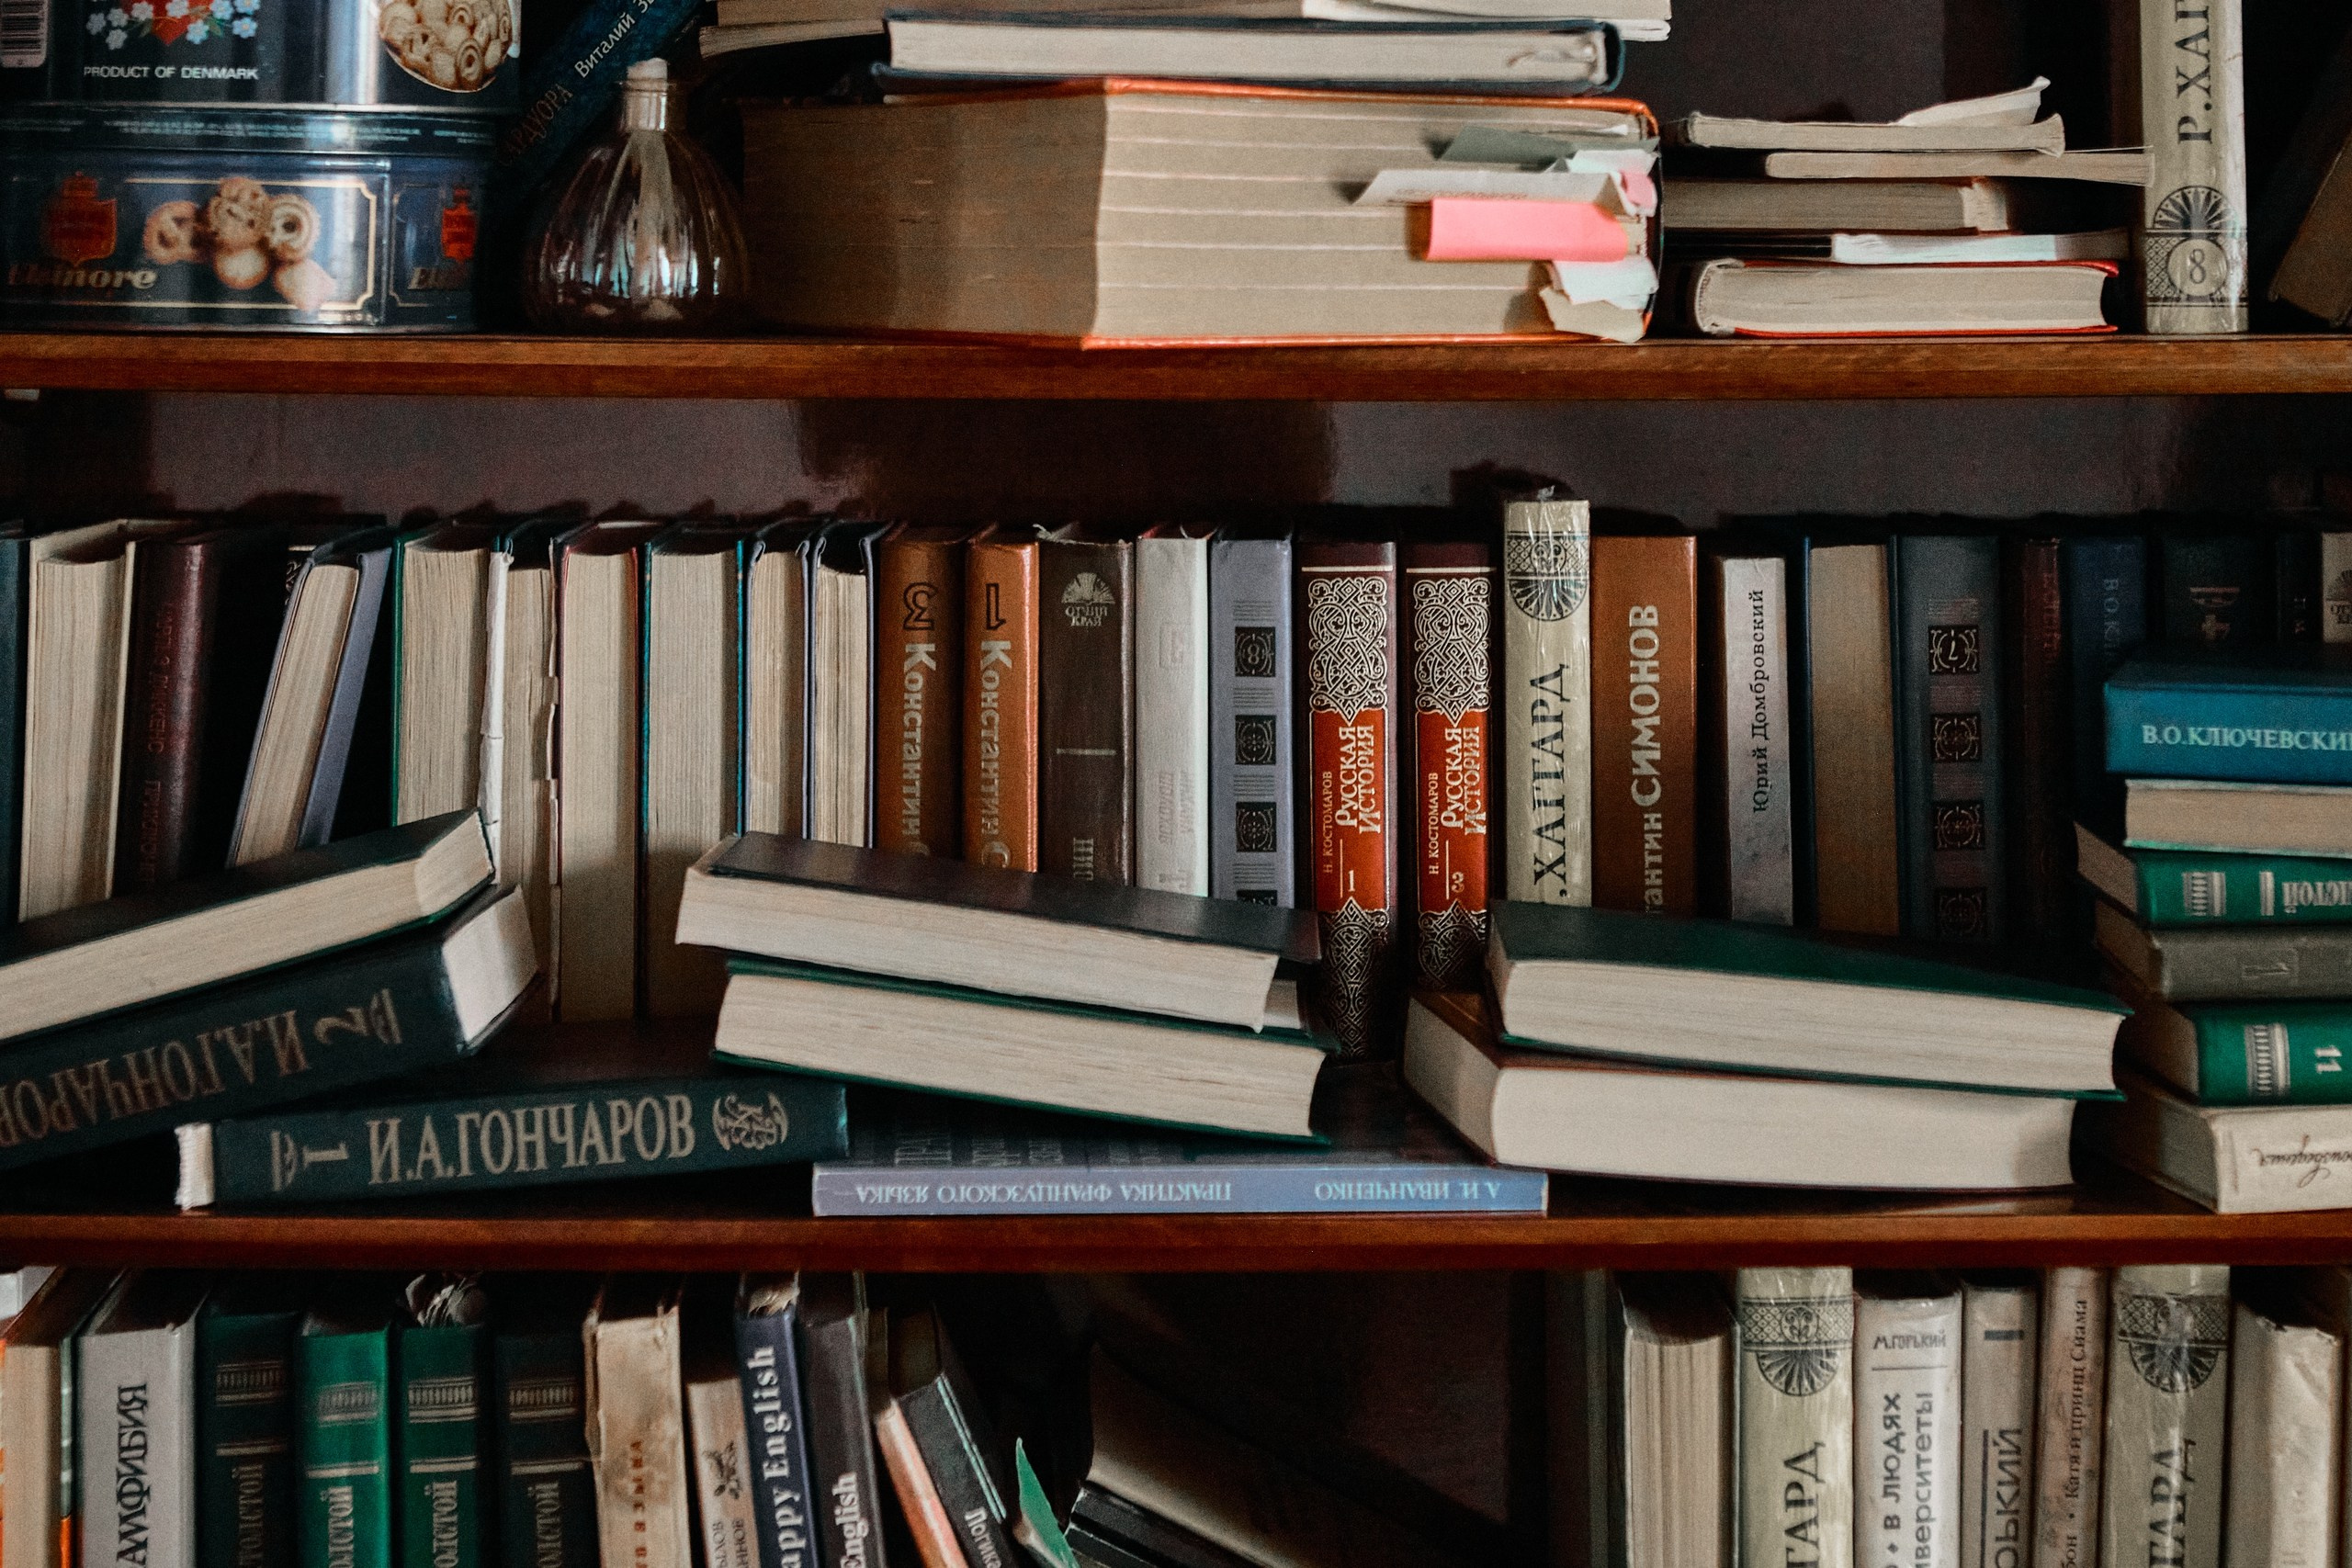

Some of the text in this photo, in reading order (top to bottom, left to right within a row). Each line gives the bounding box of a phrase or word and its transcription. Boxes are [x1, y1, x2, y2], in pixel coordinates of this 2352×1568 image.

[83, 65, 259, 80] PRODUCT OF DENMARK
[573, 11, 636, 78] Виталий
[2188, 247, 2207, 285] 8
[902, 581, 938, 631] 3
[985, 582, 1007, 631] 1
[902, 642, 937, 837] Константин
[980, 640, 1012, 836] Константин
[1629, 604, 1663, 808] СИМОНОВ
[1748, 590, 1772, 814] Юрий Домбровский
[1322, 771, 1333, 857] КОСТОМАРОВ
[1428, 772, 1440, 875] Н. КОСТОМАРОВ
[1451, 871, 1465, 894] 3
[2313, 1044, 2343, 1074] 11
[365, 1094, 696, 1185] И.А.ГОНЧАРОВ
[855, 1181, 1232, 1204] ПРАКТИКА ФРАНЦУЗСКОГО ЯЗЫКА
[1314, 1180, 1450, 1201] ИВАНЧЕНКО
[1872, 1328, 1947, 1350] М.ГОРЬКИЙ
[747, 1345, 791, 1482] English
[2064, 1299, 2088, 1499] Катя и принц Сиама
[116, 1382, 151, 1568] АМФИБИЯ
[1883, 1393, 1906, 1530] В ЛЮДЯХ
[424, 1480, 458, 1568] ОЛСТОЙ
[831, 1471, 869, 1568] English
